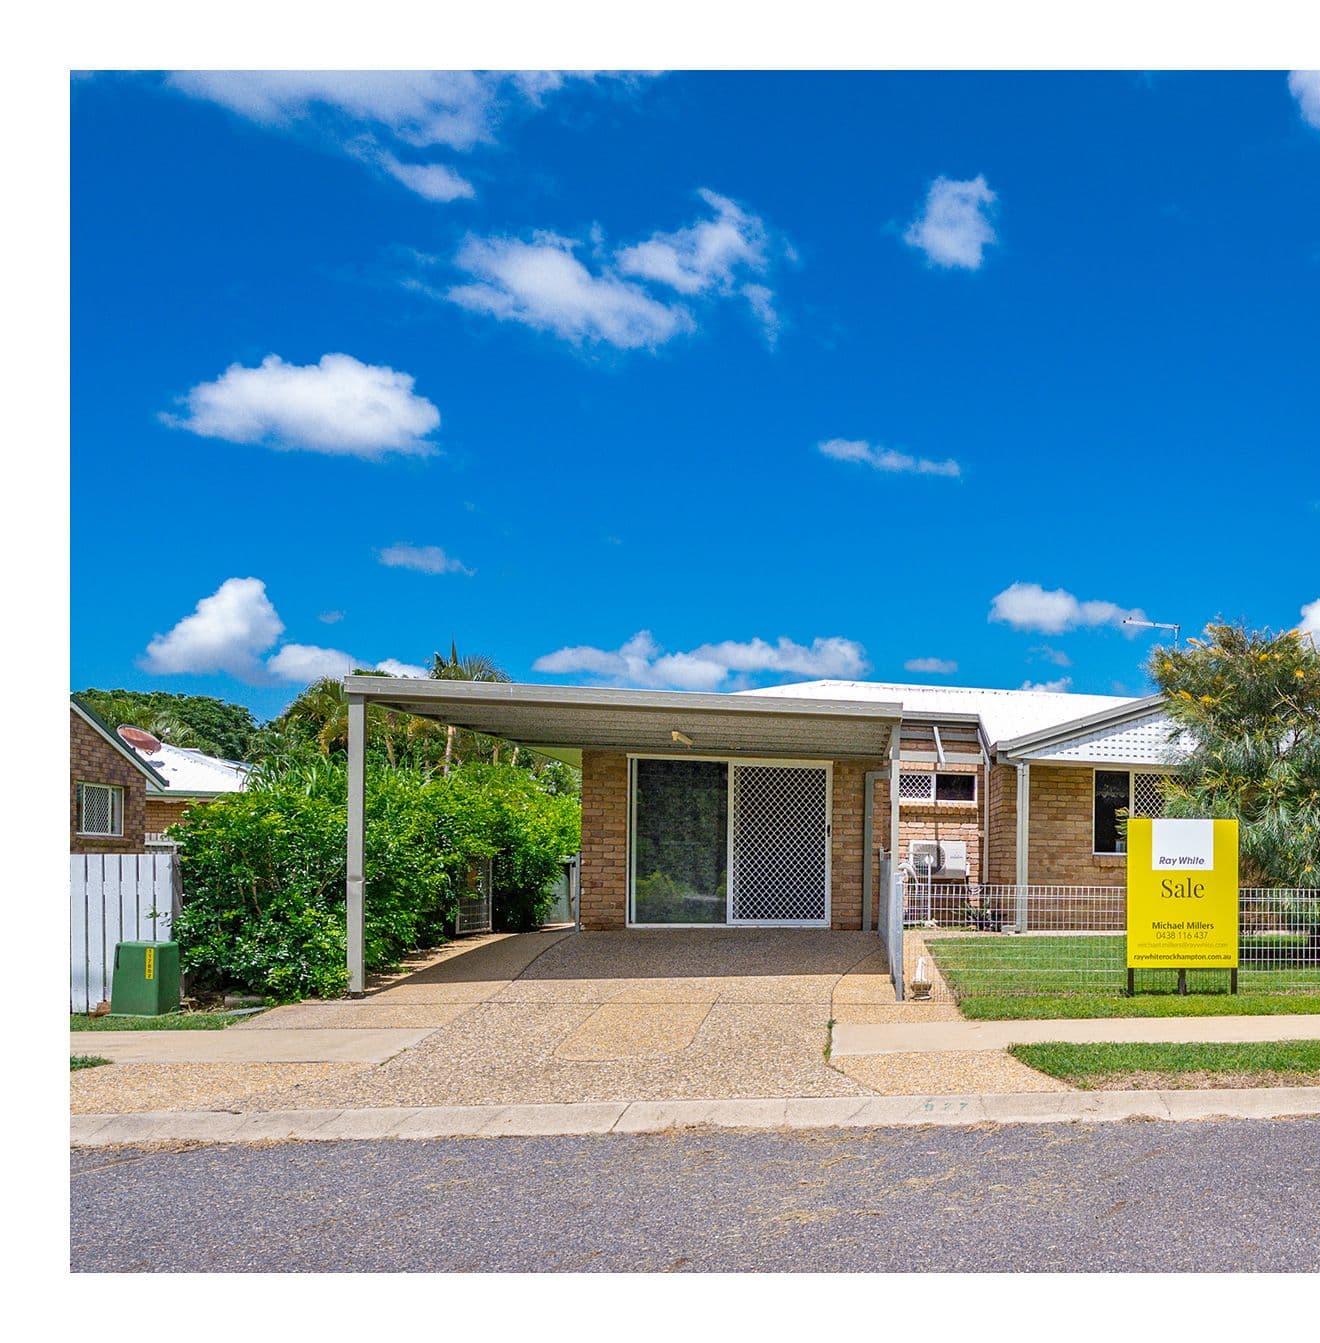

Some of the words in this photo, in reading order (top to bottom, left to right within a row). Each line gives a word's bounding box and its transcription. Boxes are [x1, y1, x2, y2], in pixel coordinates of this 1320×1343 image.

[1158, 856, 1177, 866] Ray
[1178, 856, 1205, 865] White
[1161, 877, 1205, 899] Sale
[1152, 921, 1184, 930] Michael
[1186, 921, 1214, 930] Millers
[1156, 931, 1176, 940] 0438
[1178, 931, 1192, 940] 116
[1193, 931, 1208, 940] 437
[1133, 953, 1232, 961] raywhiterockhampton.com.au
